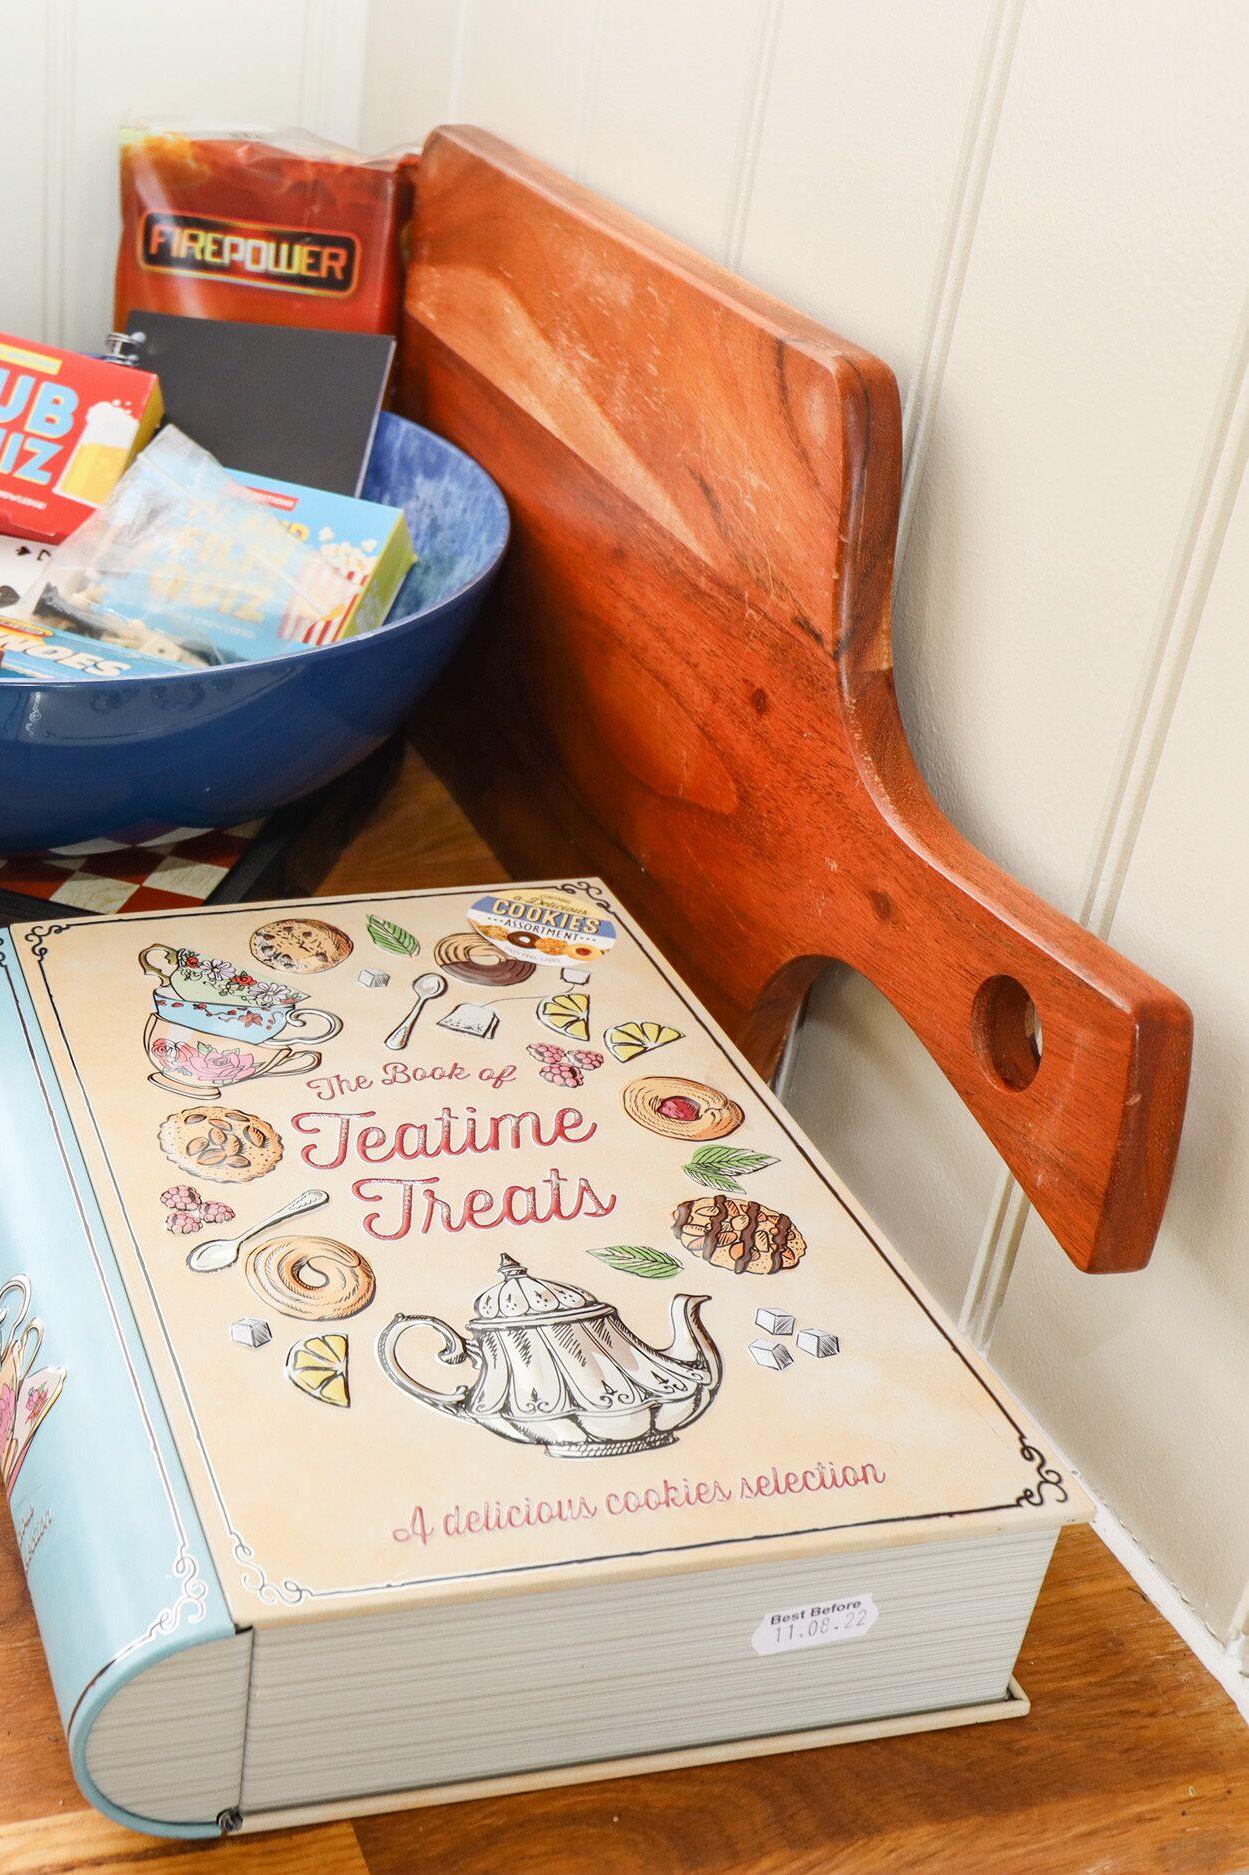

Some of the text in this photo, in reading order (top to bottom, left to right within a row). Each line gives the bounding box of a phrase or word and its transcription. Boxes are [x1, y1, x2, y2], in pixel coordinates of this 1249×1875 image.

[148, 222, 348, 281] FIREPOWER
[491, 898, 601, 935] COOKIES
[503, 917, 580, 942] ASSORTMENT
[305, 1061, 518, 1102] The Book of
[290, 1105, 599, 1171] Teatime
[350, 1167, 618, 1242] Treats
[391, 1459, 888, 1546] A delicious cookies selection
[770, 1600, 862, 1626] Best Before
[775, 1608, 868, 1644] 11.08.22
